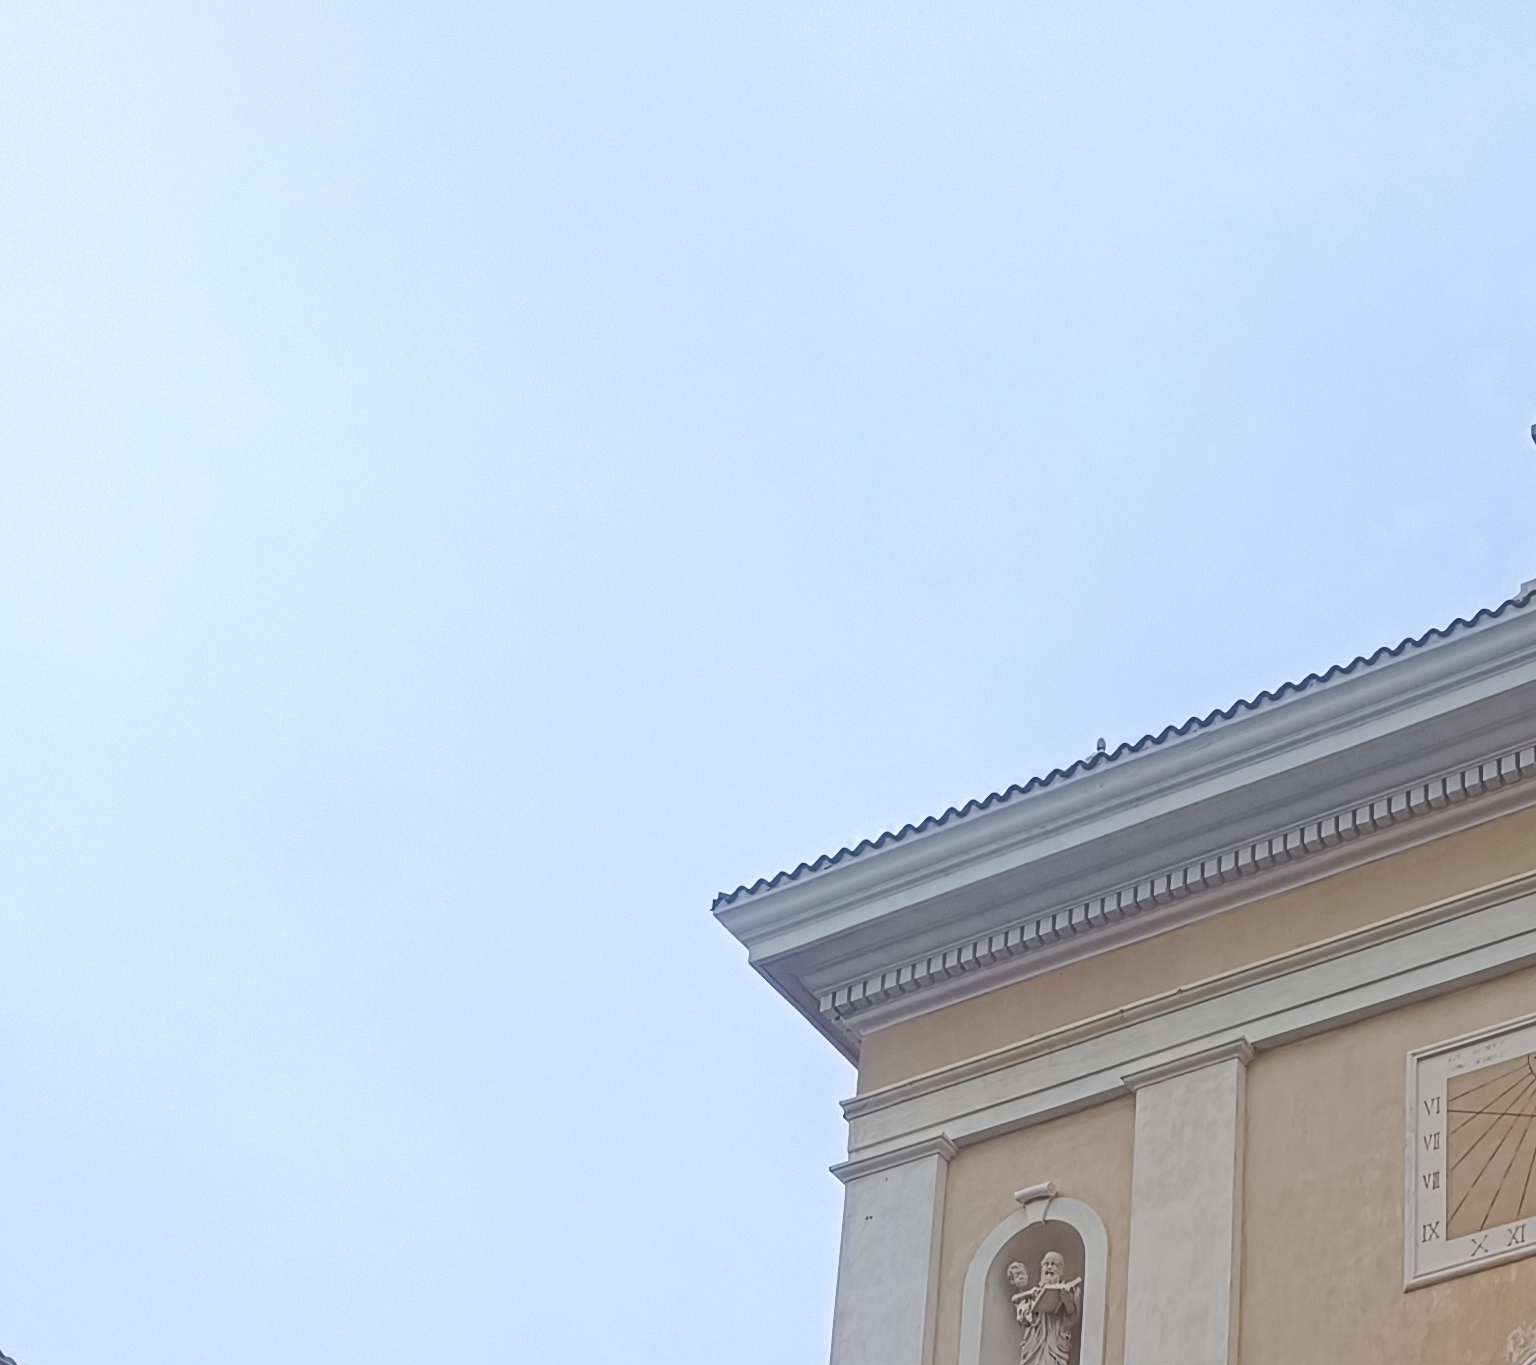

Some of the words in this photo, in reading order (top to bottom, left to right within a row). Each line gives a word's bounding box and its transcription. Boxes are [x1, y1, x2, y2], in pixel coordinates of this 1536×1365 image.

[1423, 1096, 1441, 1115] VI
[1423, 1131, 1441, 1151] VII
[1421, 1220, 1441, 1243] IX
[1507, 1223, 1527, 1247] XI
[1470, 1234, 1490, 1257] X
